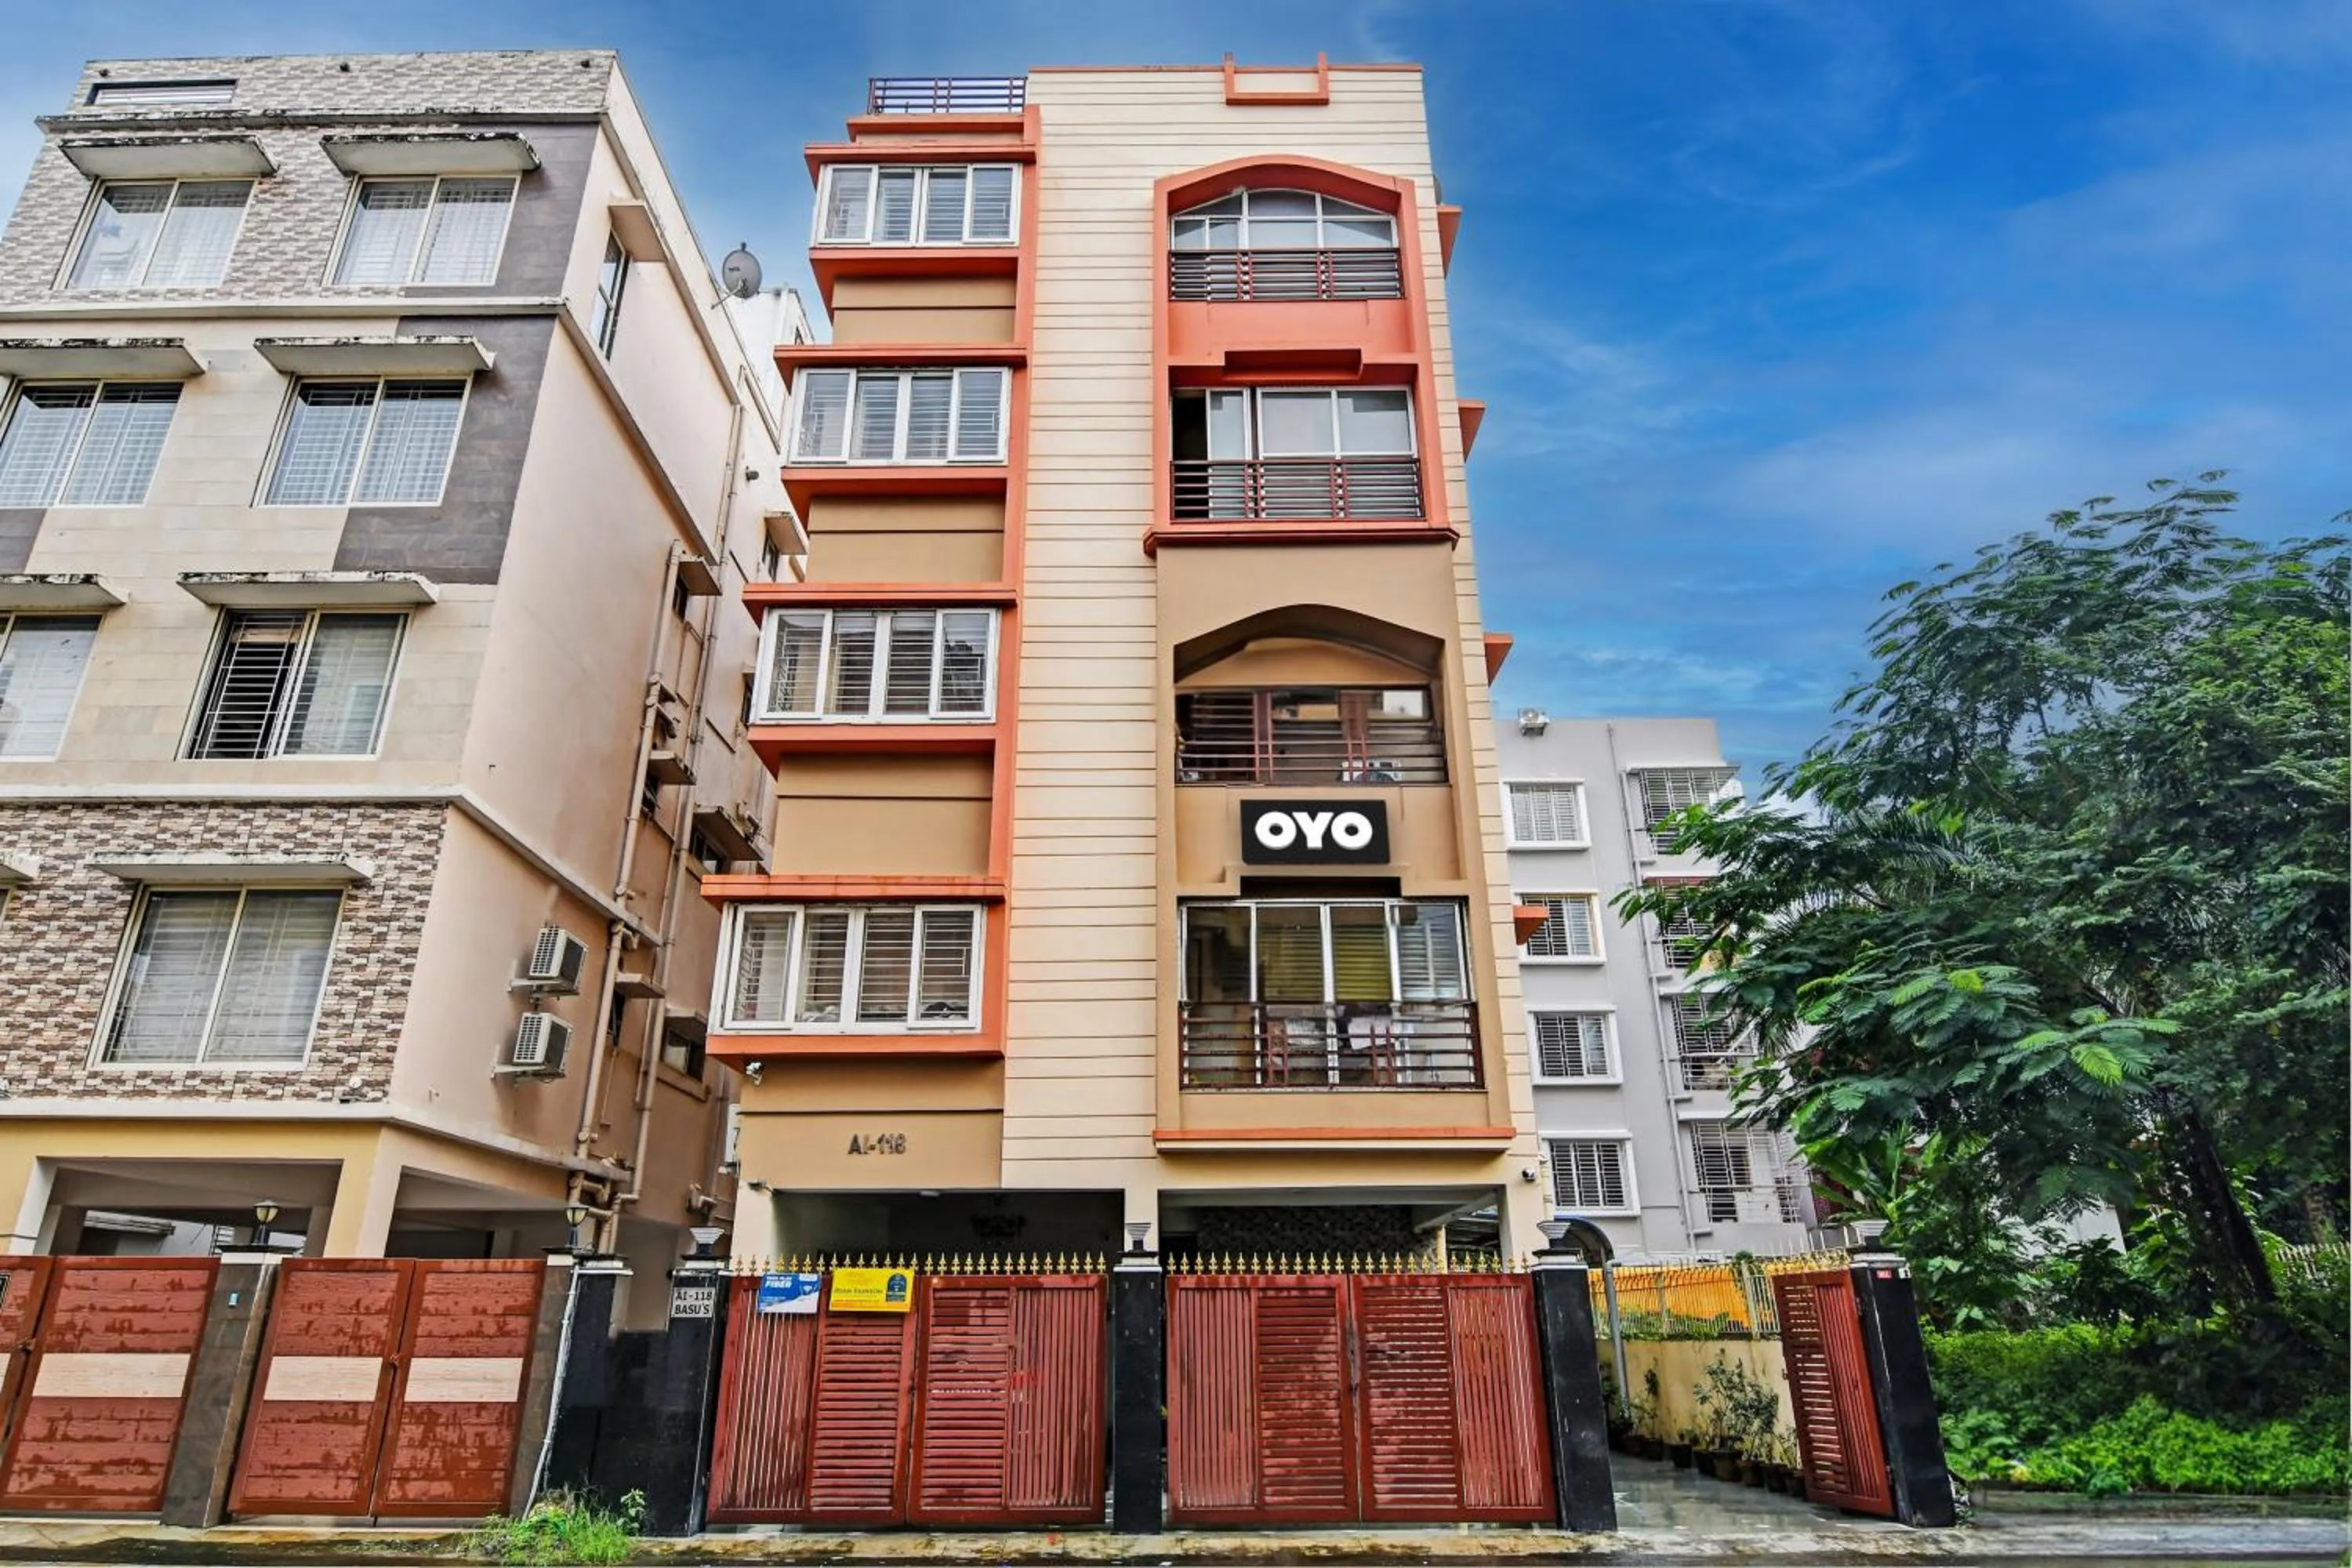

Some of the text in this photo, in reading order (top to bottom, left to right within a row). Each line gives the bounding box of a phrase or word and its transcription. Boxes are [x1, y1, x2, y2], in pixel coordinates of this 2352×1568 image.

[1255, 811, 1373, 851] OYO
[675, 1291, 712, 1301] AI-118
[675, 1302, 710, 1314] BASU'S
